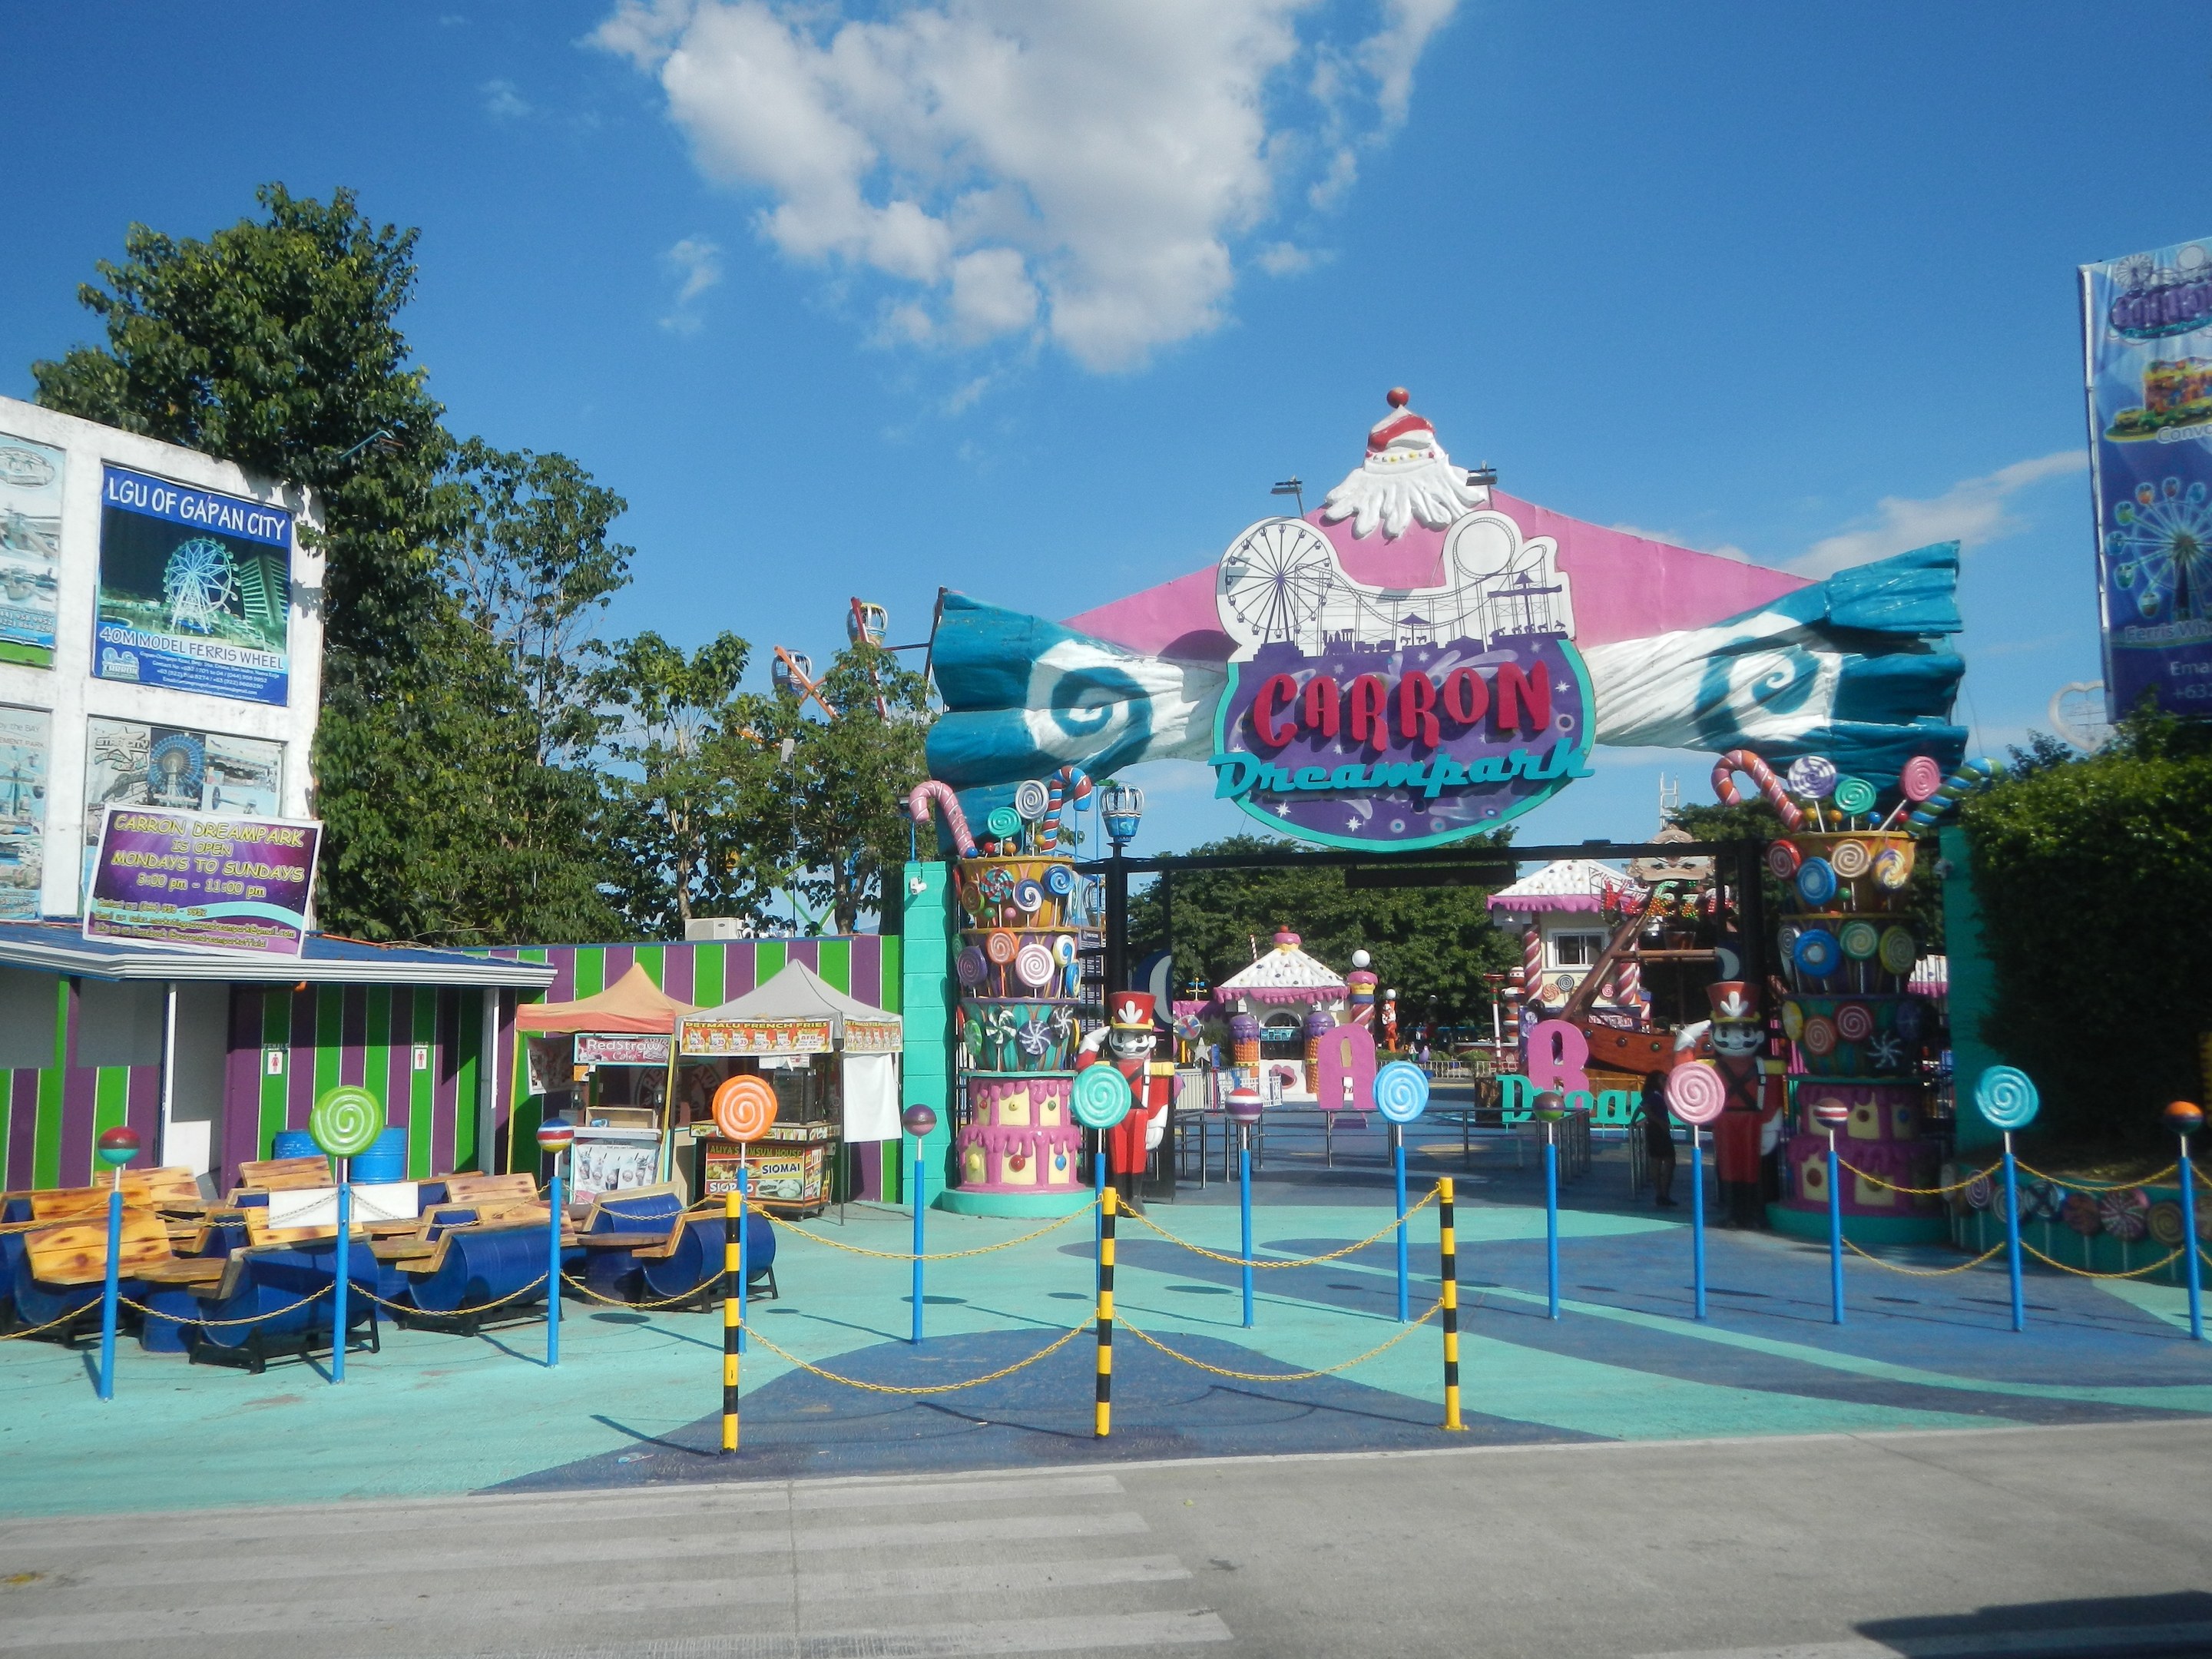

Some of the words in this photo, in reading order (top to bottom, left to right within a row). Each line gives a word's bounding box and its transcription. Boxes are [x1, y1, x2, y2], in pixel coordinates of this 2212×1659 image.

[109, 477, 147, 507] LGU
[152, 487, 177, 514] OF
[247, 512, 286, 540] CITY
[2124, 623, 2173, 642] Ferris
[100, 626, 137, 646] 40M
[139, 634, 185, 654] MODEL
[189, 643, 237, 661] FERRIS
[240, 651, 284, 670] WHEEL
[1253, 661, 1552, 751] CARRON
[96, 737, 124, 747] STAR
[127, 738, 149, 749] CITY
[1207, 737, 1596, 800] Dreampark
[114, 814, 187, 835] CARRON
[192, 821, 305, 847] DREAMPARK
[171, 839, 189, 852] IS
[194, 842, 233, 856] OPEN
[111, 850, 189, 870] MONDAYS
[194, 858, 218, 873] TO
[223, 861, 305, 882] SUNDAYS
[169, 878, 188, 891] pm
[204, 879, 243, 894] 11:00
[246, 885, 266, 898] pm
[710, 1145, 740, 1155] ALIYA'S
[743, 1147, 773, 1157] IMSUM
[775, 1148, 802, 1158] HOUSE
[762, 1163, 800, 1174] SIOMAI
[709, 1182, 753, 1193] SIOPO
